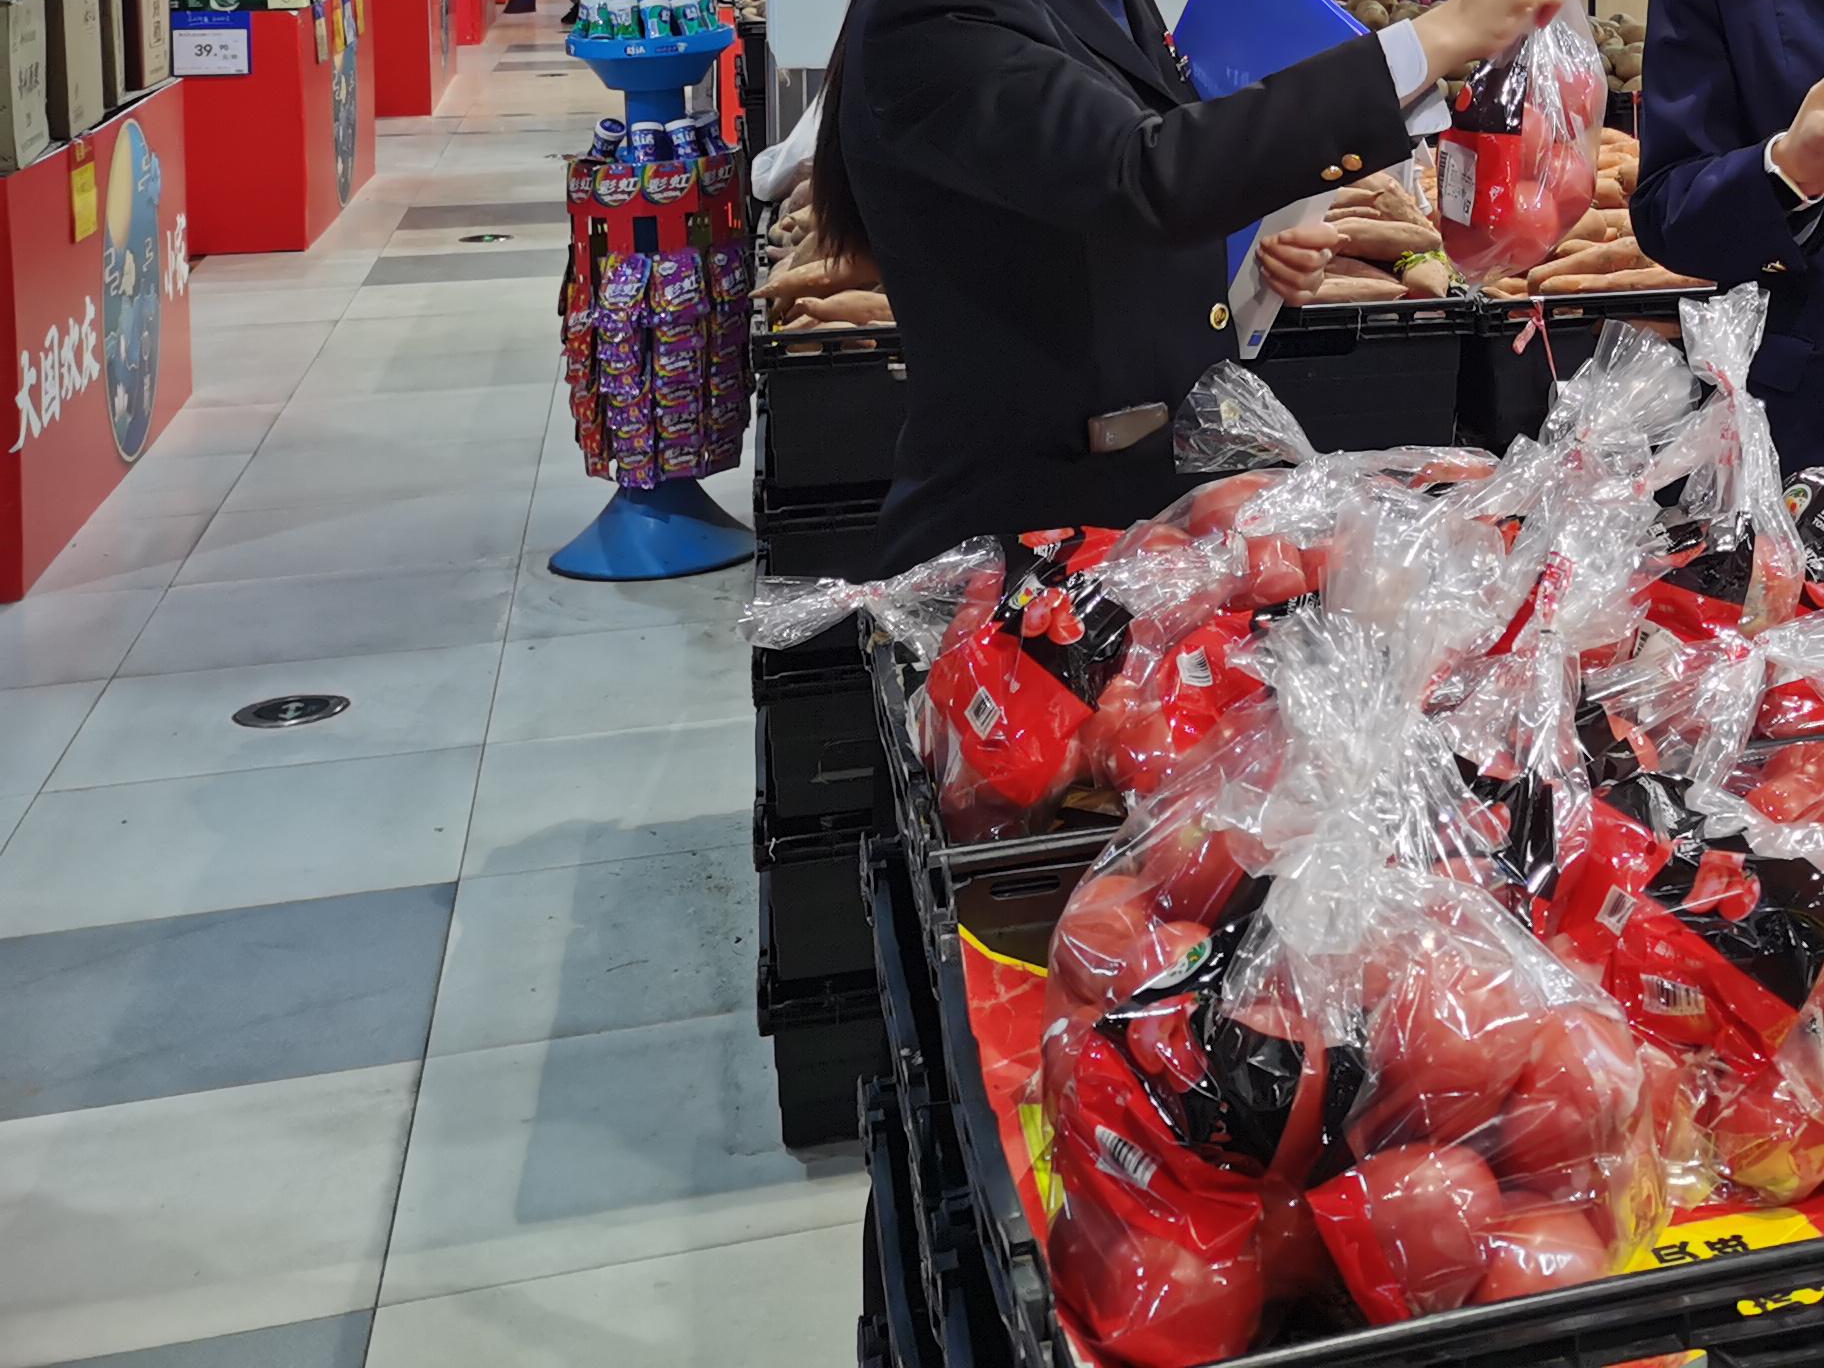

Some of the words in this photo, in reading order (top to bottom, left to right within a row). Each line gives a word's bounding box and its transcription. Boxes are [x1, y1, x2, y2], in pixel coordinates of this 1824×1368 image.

[599, 177, 639, 193] 彩虹
[648, 173, 692, 193] 彩虹
[9, 295, 100, 453] 大国欢庆
